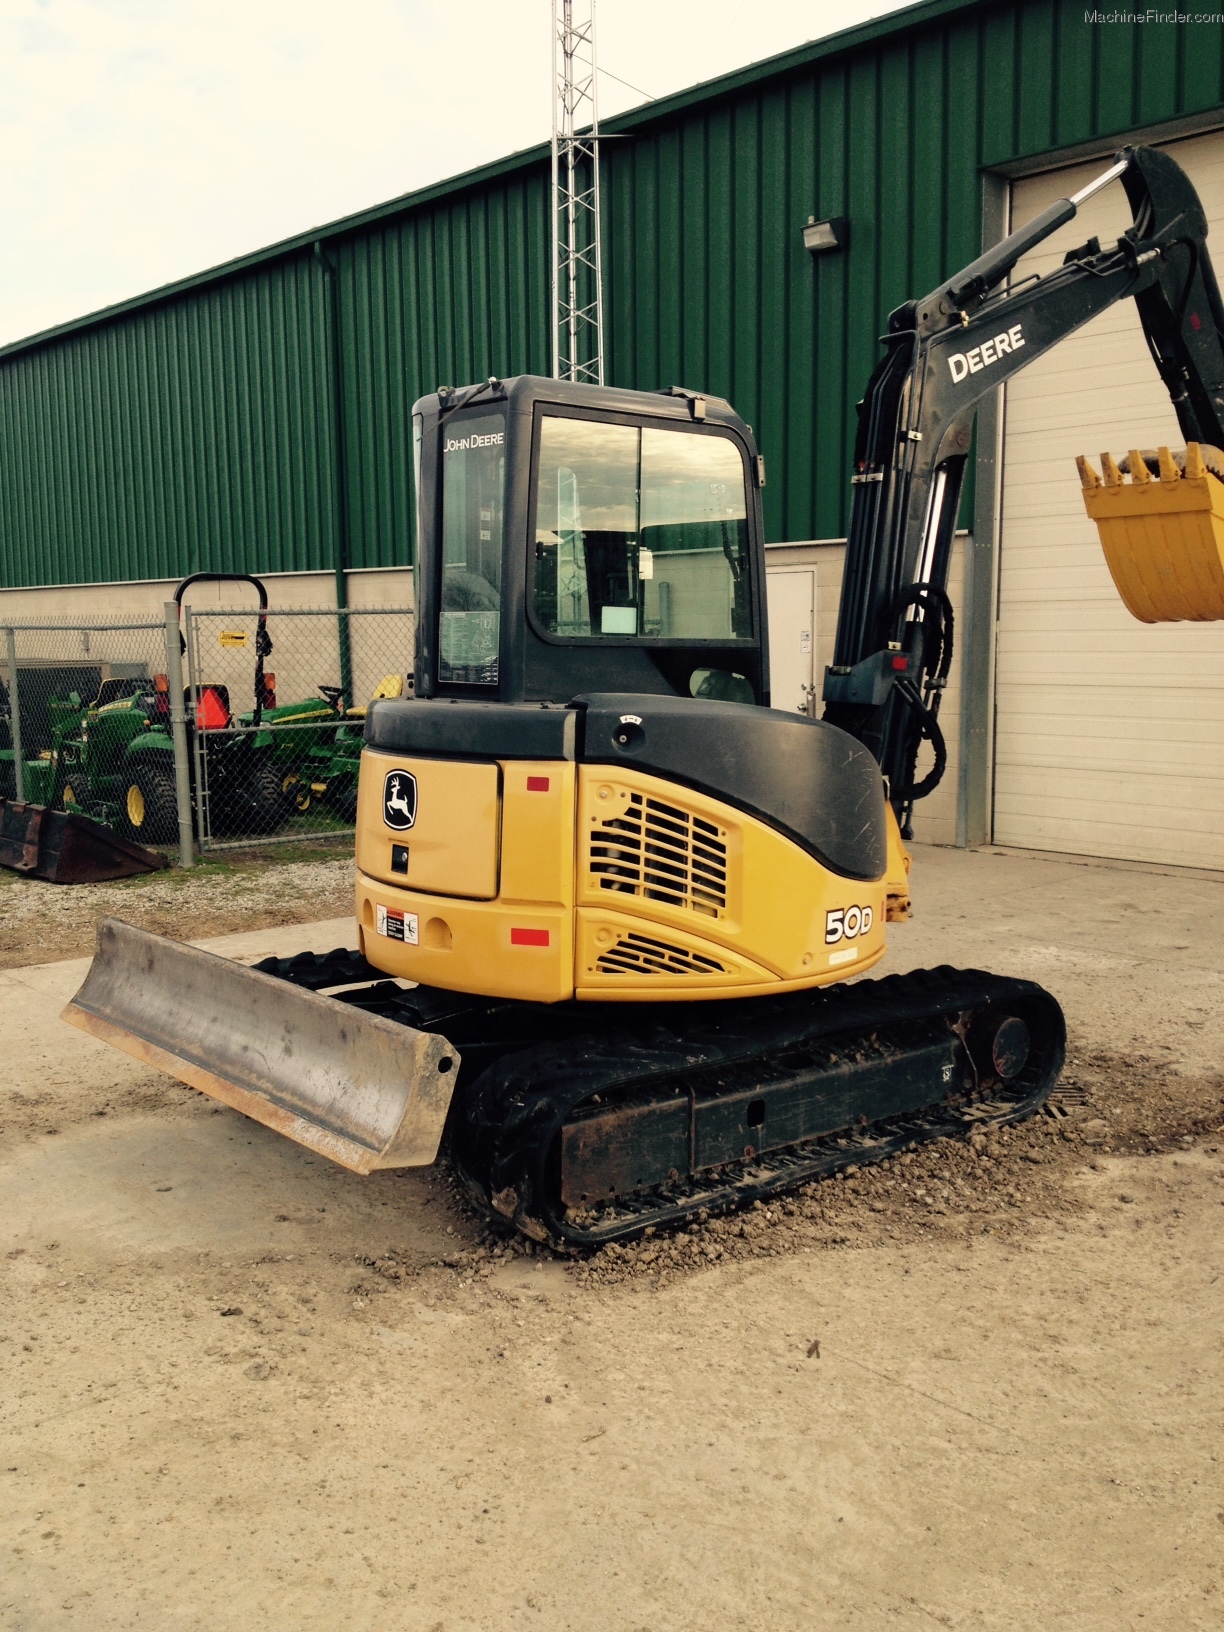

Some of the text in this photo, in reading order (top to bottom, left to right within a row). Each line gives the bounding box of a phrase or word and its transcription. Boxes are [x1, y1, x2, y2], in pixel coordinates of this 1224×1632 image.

[947, 323, 1026, 384] DEERE
[443, 432, 504, 453] JOHN DEERE
[825, 904, 873, 945] 50D
